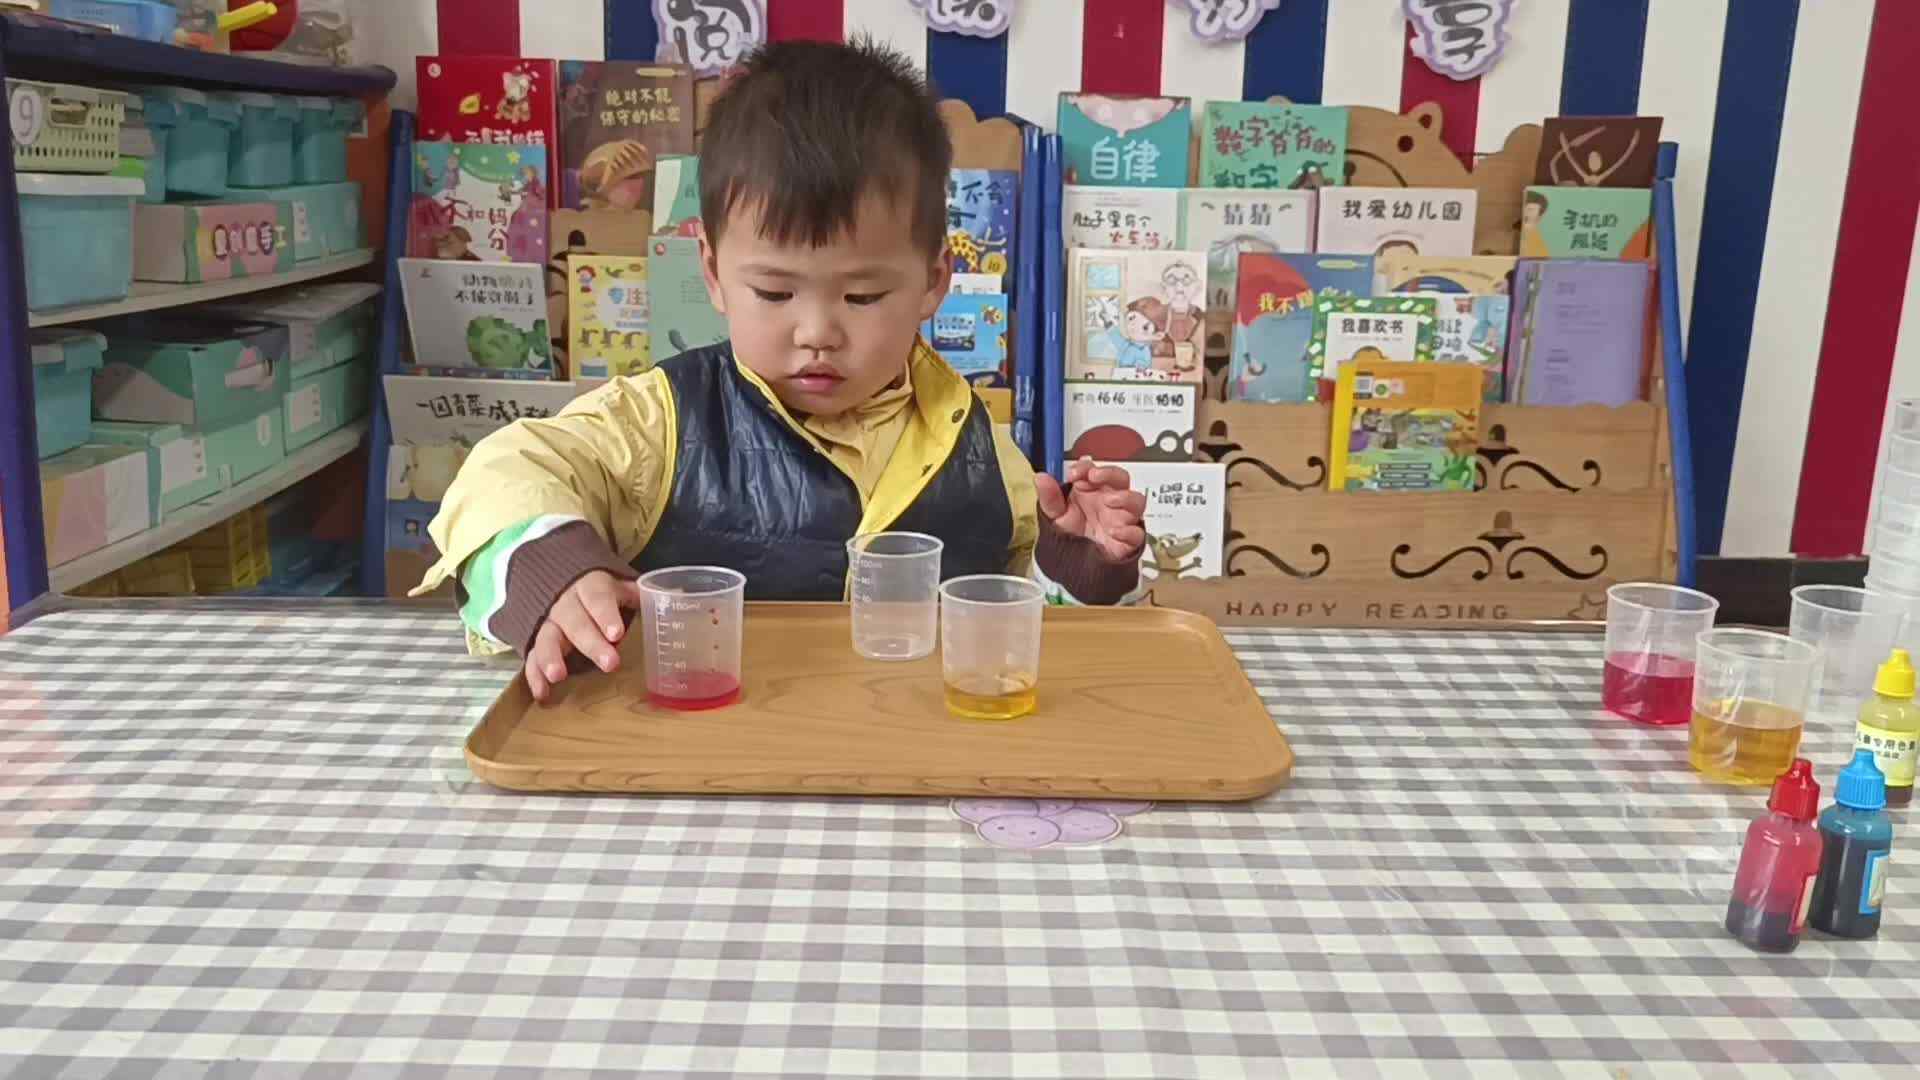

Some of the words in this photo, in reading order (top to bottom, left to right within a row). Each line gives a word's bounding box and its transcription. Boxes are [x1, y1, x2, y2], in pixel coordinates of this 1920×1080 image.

[18, 96, 35, 137] 9
[1090, 137, 1161, 183] 自律
[1223, 204, 1271, 225] 猜猜
[1341, 199, 1464, 221] 我爱幼儿园
[1341, 318, 1405, 334] 我喜欢书
[1226, 602, 1338, 617] HAPPY
